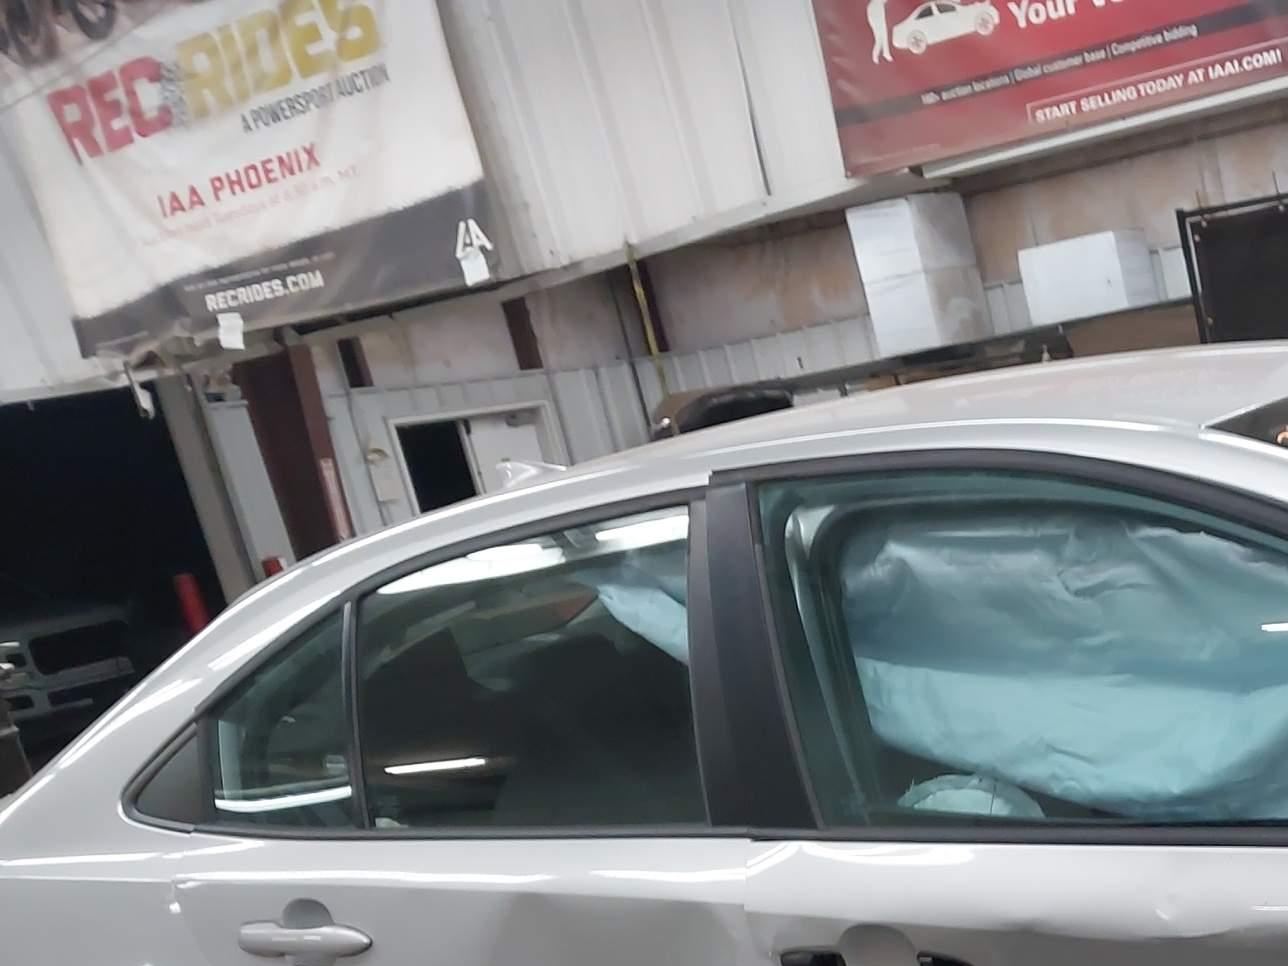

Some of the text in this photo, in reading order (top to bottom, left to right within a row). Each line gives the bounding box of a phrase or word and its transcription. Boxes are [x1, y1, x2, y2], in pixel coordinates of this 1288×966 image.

[1007, 0, 1077, 28] Your
[240, 62, 391, 133] A POWERSPORT AUCTION
[1035, 48, 1282, 123] START SELLING TODAY AT IAAI.COM!
[157, 185, 205, 218] IAA
[209, 142, 321, 201] PHOENIX
[204, 270, 325, 312] RECRIDES.COM
